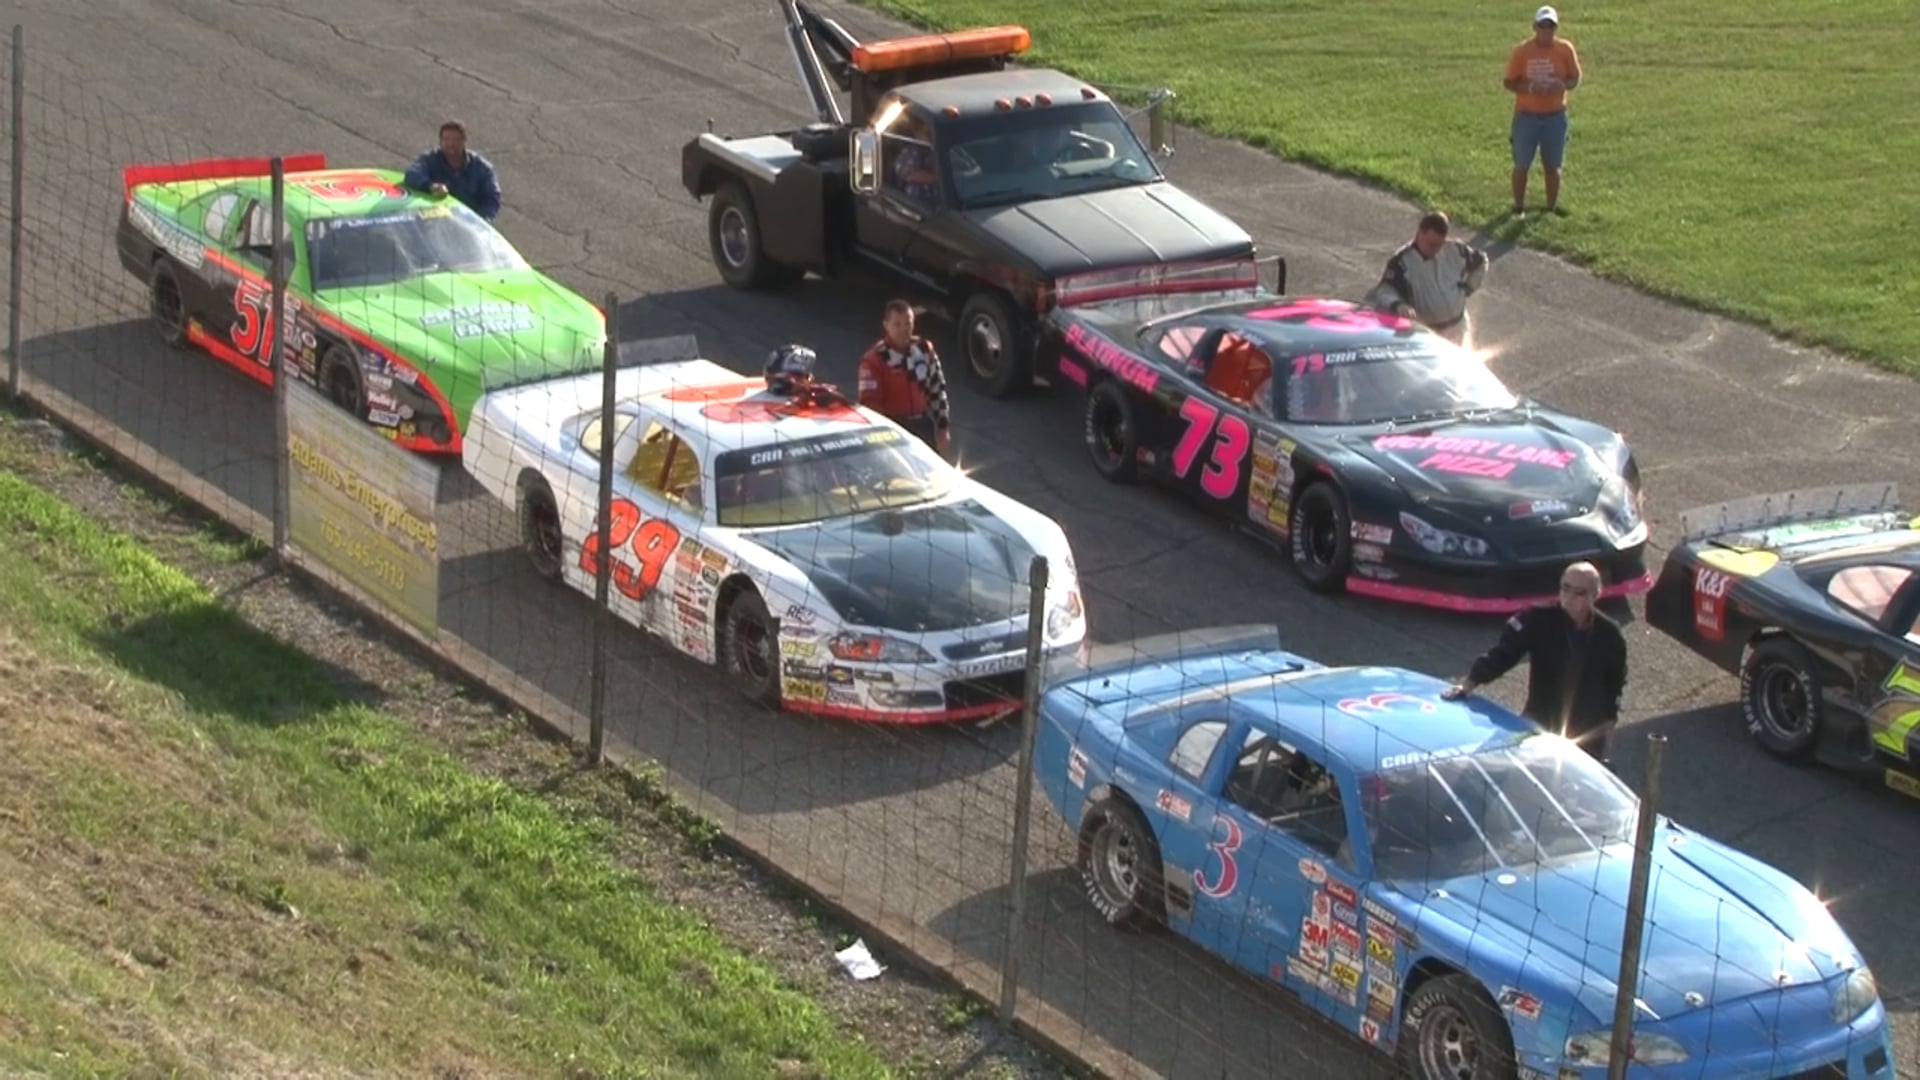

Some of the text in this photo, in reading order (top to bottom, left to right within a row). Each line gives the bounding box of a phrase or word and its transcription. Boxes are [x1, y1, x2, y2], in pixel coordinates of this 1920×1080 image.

[1065, 321, 1160, 394] PLATINUM
[1291, 350, 1325, 379] 73
[750, 448, 783, 466] CRA
[1172, 394, 1250, 498] 73
[1372, 434, 1577, 469] VICTORY LANE
[1418, 452, 1517, 478] PIZZA
[288, 432, 341, 489] Adams
[345, 470, 438, 553] Enterprises
[578, 497, 681, 603] 29
[1695, 567, 1730, 598] K&S
[1194, 813, 1242, 897] 3
[1304, 920, 1328, 948] 3M
